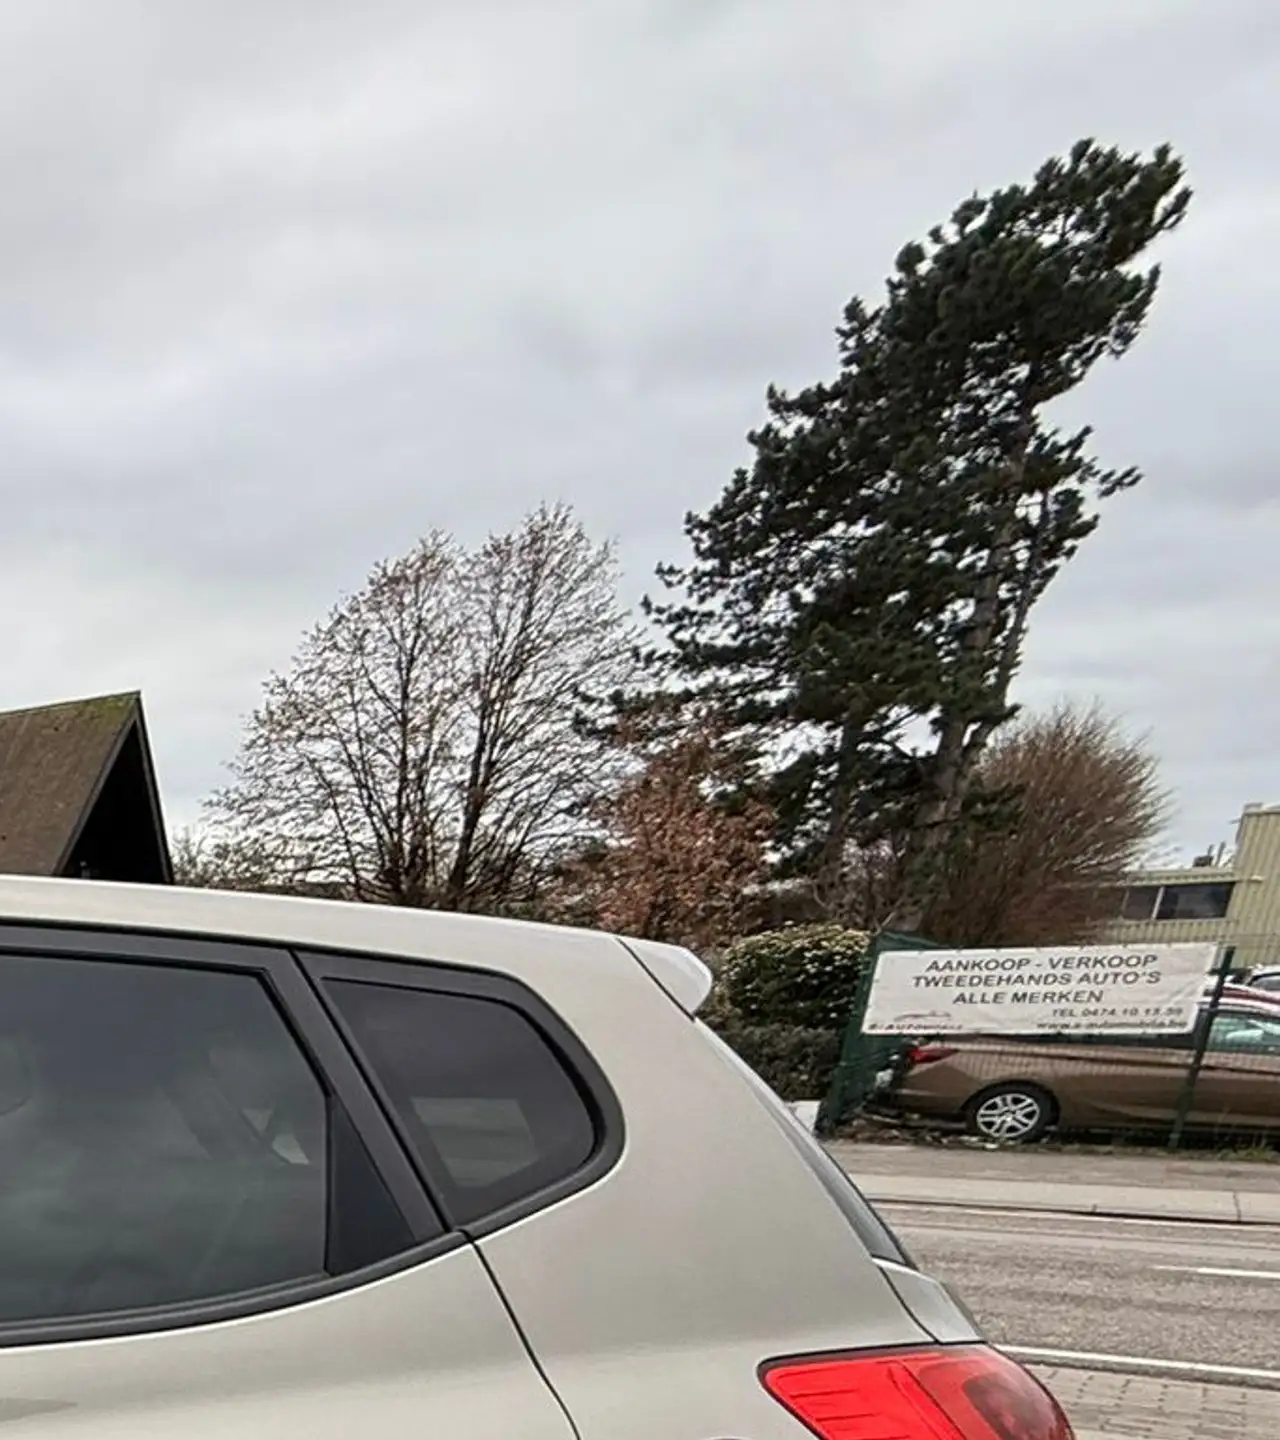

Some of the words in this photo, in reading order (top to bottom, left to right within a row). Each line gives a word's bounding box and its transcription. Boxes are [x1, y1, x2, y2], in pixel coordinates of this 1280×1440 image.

[926, 958, 1031, 972] AANKOOP
[1048, 954, 1158, 969] VERKOOP
[912, 973, 1072, 988] TWEEDEHANDS
[1076, 970, 1162, 985] AUTO'S
[952, 991, 1005, 1004] ALLE
[1010, 990, 1104, 1004] MERKEN
